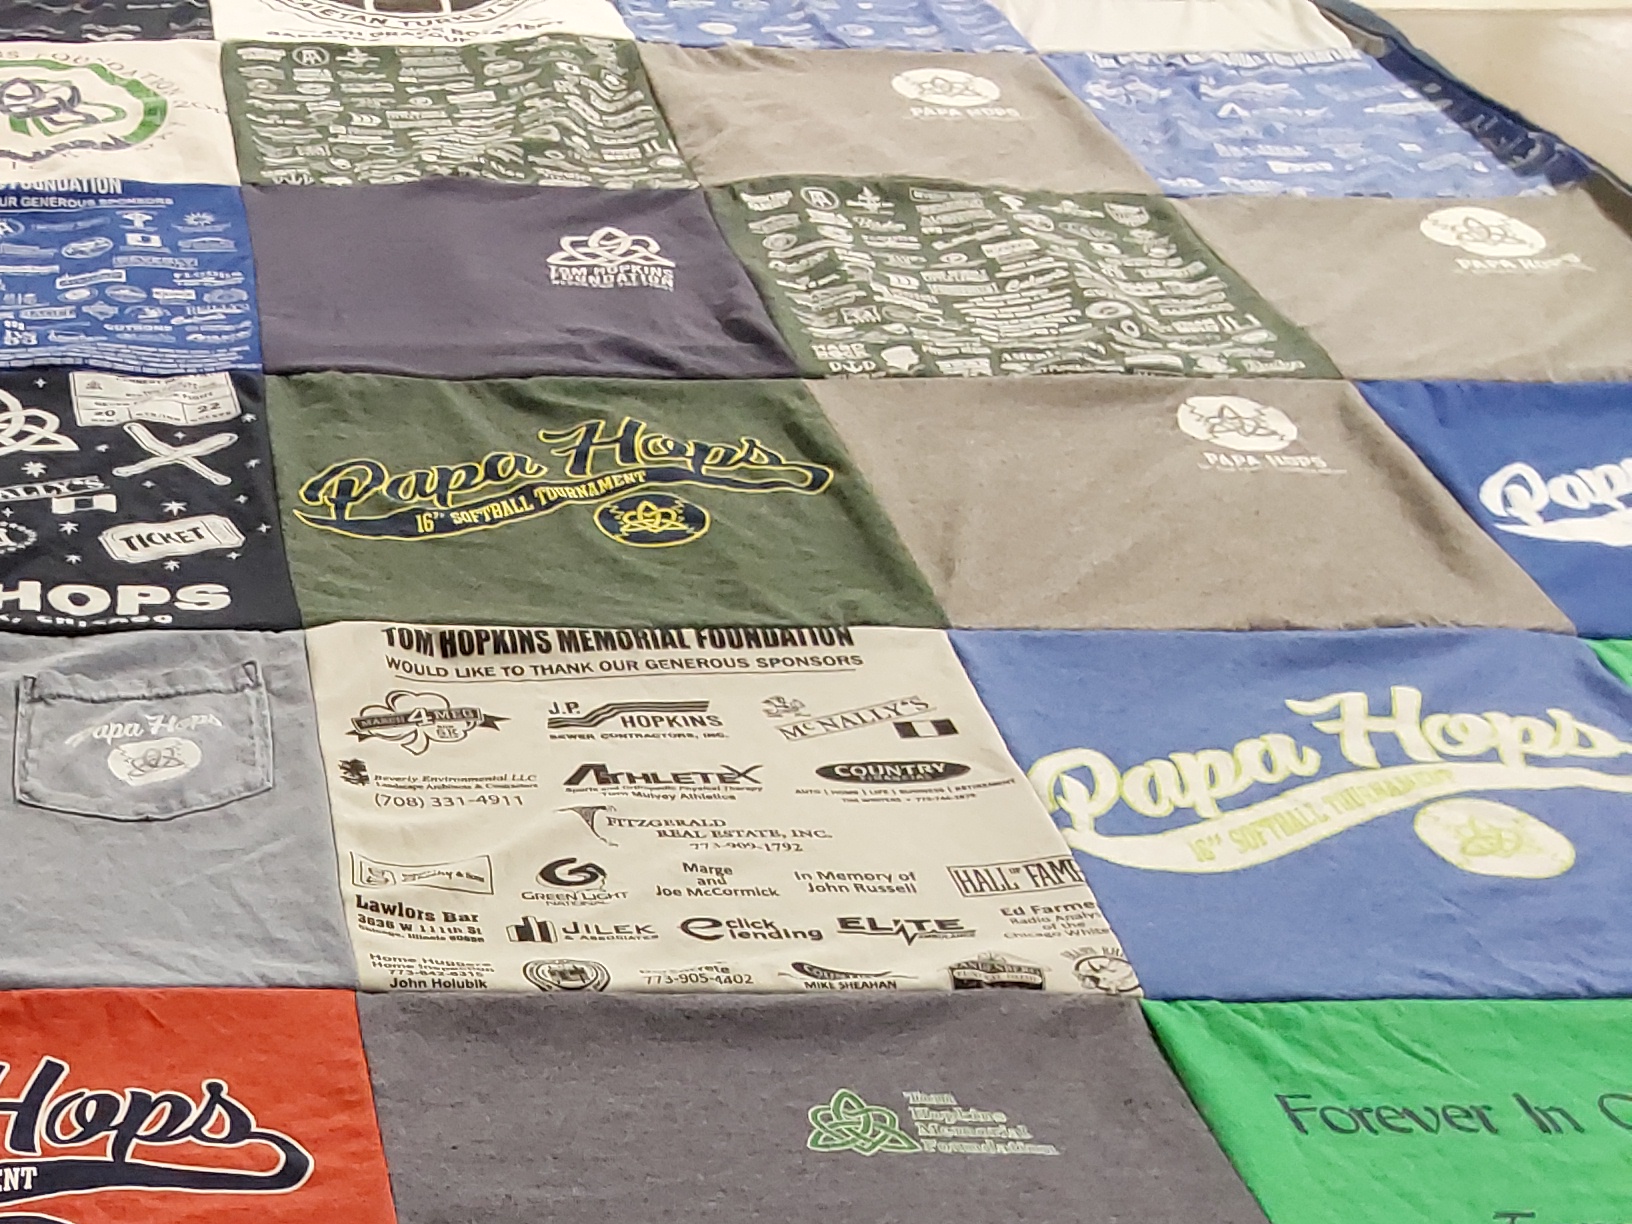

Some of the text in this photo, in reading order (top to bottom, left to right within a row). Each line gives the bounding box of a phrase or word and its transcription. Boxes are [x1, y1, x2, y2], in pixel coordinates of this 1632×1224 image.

[594, 264, 674, 279] HOPKINS
[298, 415, 790, 522] Papa Hops
[449, 494, 537, 526] SOFTBALL
[531, 469, 649, 509] TOURNAMENT
[119, 525, 205, 551] TICKET
[381, 626, 855, 659] TOM HOPKINS MEMORIAL FOUNDATION
[384, 655, 865, 679] WOULD LIKE TO THANK OUR GENEROUS SPONSORS
[143, 712, 224, 737] Hops
[405, 707, 436, 728] 4
[620, 714, 724, 730] HOPKINS
[1028, 685, 1632, 832] Papa Hops
[833, 762, 947, 778] COUNTRY
[373, 773, 418, 784] Beverly
[511, 772, 538, 782] LLC
[374, 793, 525, 808] (708) 331-4911
[605, 815, 728, 828] FITZGERALD
[1229, 802, 1329, 853] SOFTBALL
[656, 828, 707, 839] REAL
[791, 828, 833, 839] INC.
[681, 861, 734, 876] Marge
[696, 874, 729, 887] and
[794, 870, 918, 883] In Memory of
[954, 866, 1020, 895] HALL
[655, 884, 781, 898] Joe McCormick
[807, 882, 918, 895] John Russell
[354, 893, 480, 924] Lawlors Bar
[999, 905, 1025, 917] Ed
[399, 922, 413, 932] W
[466, 925, 483, 936] St
[561, 920, 656, 935] JILEK
[725, 918, 778, 931] click
[729, 926, 825, 941] lending
[389, 977, 488, 989] John Holubik
[803, 981, 898, 990] MIKE SHEAHAN
[1274, 1093, 1499, 1136] Forever
[1511, 1092, 1586, 1135] In
